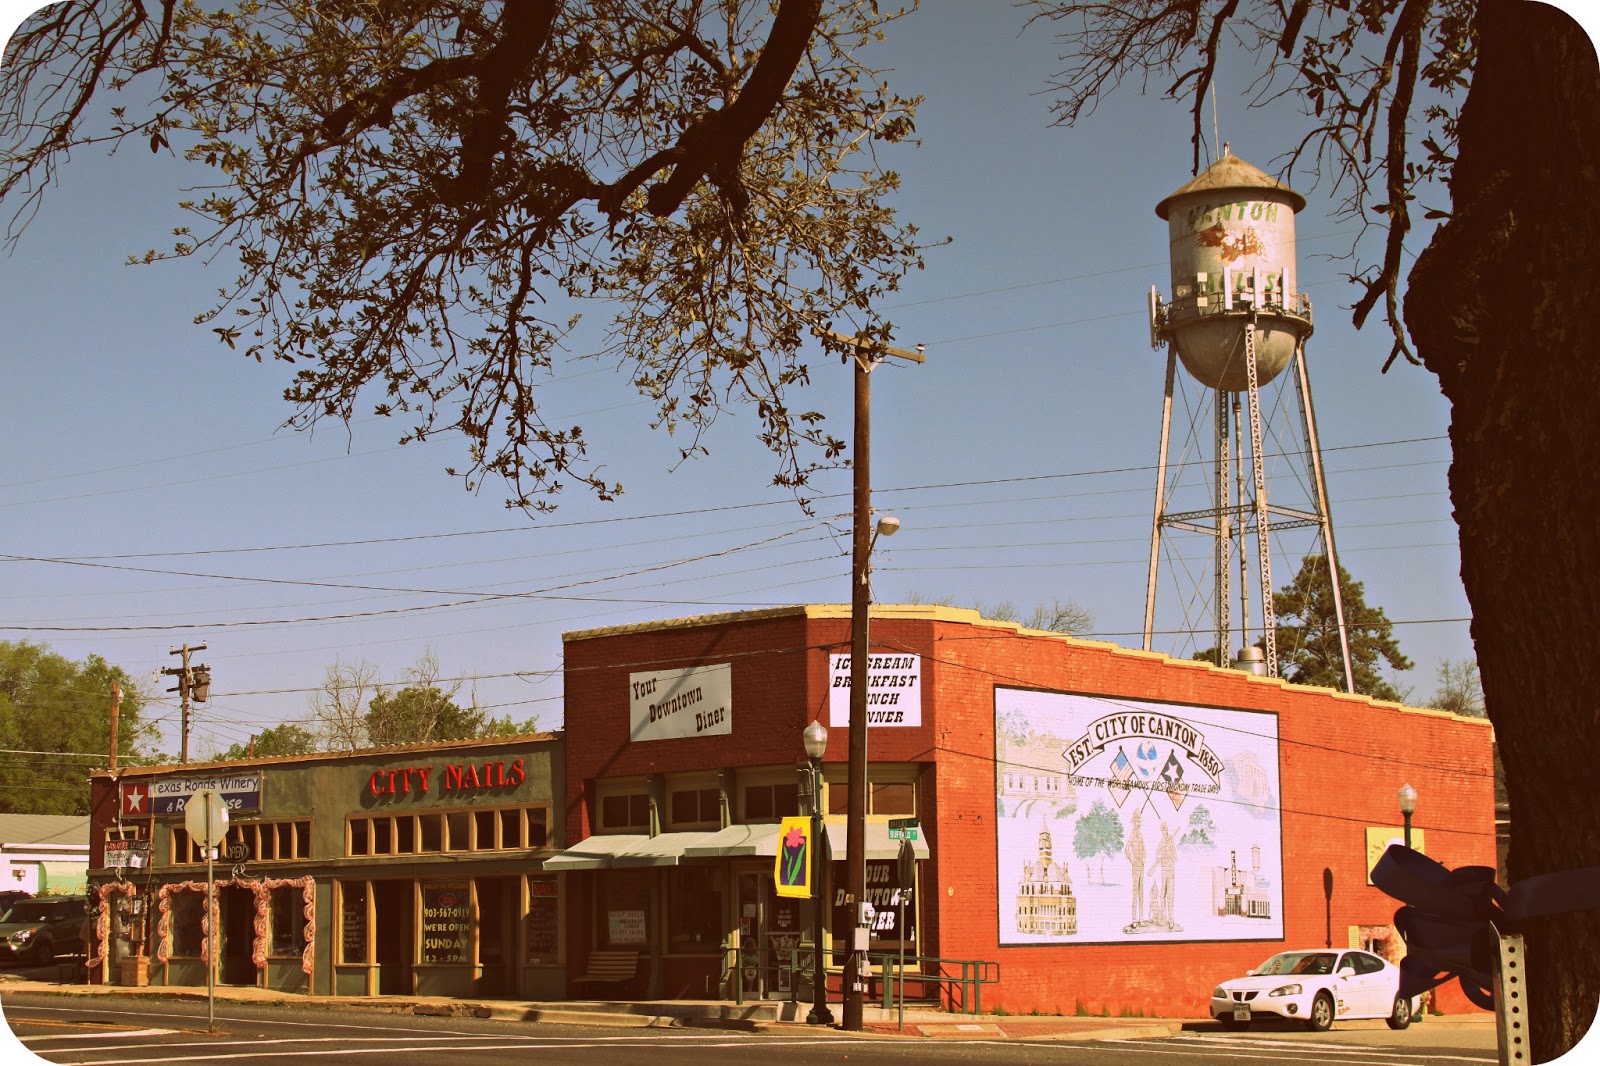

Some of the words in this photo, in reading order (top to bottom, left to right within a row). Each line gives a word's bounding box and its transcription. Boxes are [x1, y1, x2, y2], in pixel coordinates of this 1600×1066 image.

[835, 657, 851, 669] IC
[833, 675, 917, 688] BRKFAST
[633, 678, 657, 700] Your
[649, 686, 703, 723] Downtown
[867, 693, 900, 705] NCH
[695, 706, 725, 732] Diner
[867, 711, 904, 723] NNER
[1069, 738, 1094, 768] EST.
[1095, 715, 1128, 741] CITY
[1130, 715, 1146, 734] OF
[1149, 716, 1198, 750] CANTON
[1199, 749, 1220, 777] 1850
[369, 765, 433, 796] CITY
[445, 758, 526, 790] NAILS
[220, 777, 259, 792] Winery
[1068, 776, 1083, 787] HOME
[1085, 777, 1093, 787] OF
[1094, 778, 1105, 788] THE
[1191, 783, 1207, 794] TRADE
[166, 802, 173, 813] &
[889, 830, 911, 838] BUFFLO
[226, 845, 245, 859] OPEN
[866, 864, 890, 883] OUR
[835, 887, 913, 907] DNTOW
[424, 907, 470, 918] 903-567-0919
[424, 923, 447, 932] WE'RE
[448, 923, 470, 932] OPEN
[425, 938, 468, 949] SUNDAY
